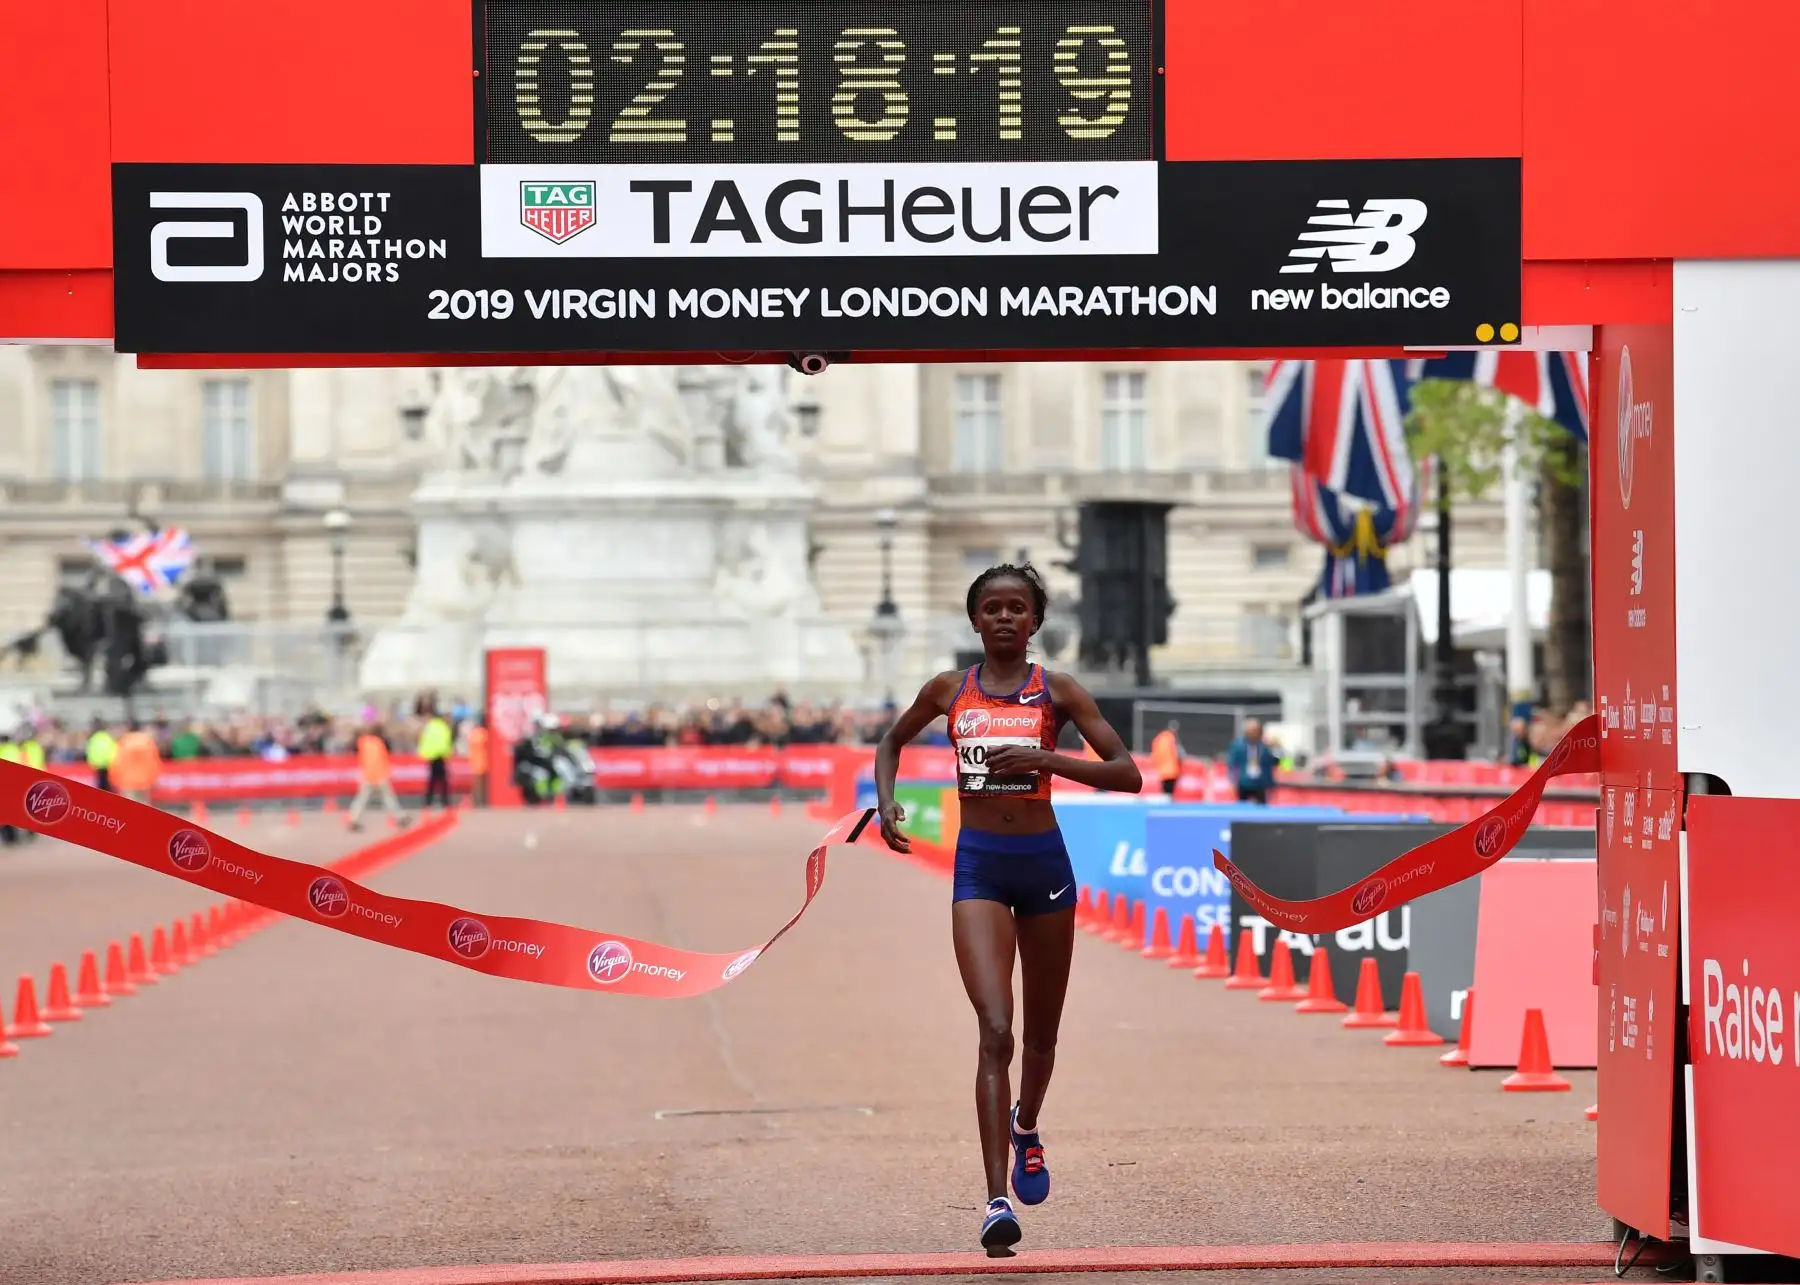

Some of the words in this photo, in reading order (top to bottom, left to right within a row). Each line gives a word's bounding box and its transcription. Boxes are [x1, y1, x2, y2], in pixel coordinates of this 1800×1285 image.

[515, 26, 1131, 142] 02:18:19
[282, 192, 391, 213] ABBOTT
[527, 186, 588, 205] TAG
[282, 215, 382, 236] WORLD
[526, 209, 590, 238] HEUER
[283, 238, 447, 259] MARATHON
[283, 262, 400, 283] MAJORS
[428, 289, 514, 320] 2019
[524, 289, 655, 319] VIRGIN
[668, 287, 811, 318] MONEY
[821, 287, 988, 318] LONDON
[1000, 285, 1217, 317] MARATHON
[1251, 287, 1315, 311] new
[1322, 282, 1451, 310] balance
[957, 709, 988, 737] Virgin
[993, 717, 1039, 730] money
[1001, 783, 1032, 791] balance
[29, 785, 67, 819] Virgin
[70, 804, 126, 835] money
[1477, 823, 1504, 854] Virgin
[1506, 794, 1535, 829] money
[173, 834, 207, 866] Virgin
[211, 856, 264, 885] money
[1354, 880, 1385, 913] Virgin
[1387, 861, 1436, 892] money
[312, 880, 346, 912] Virgin
[350, 902, 403, 929] money
[1256, 896, 1309, 924] money
[451, 922, 487, 953] Virgin
[491, 938, 546, 960] money
[592, 945, 629, 977] Virgin
[632, 961, 687, 983] money
[1703, 958, 1784, 1067] Raise
